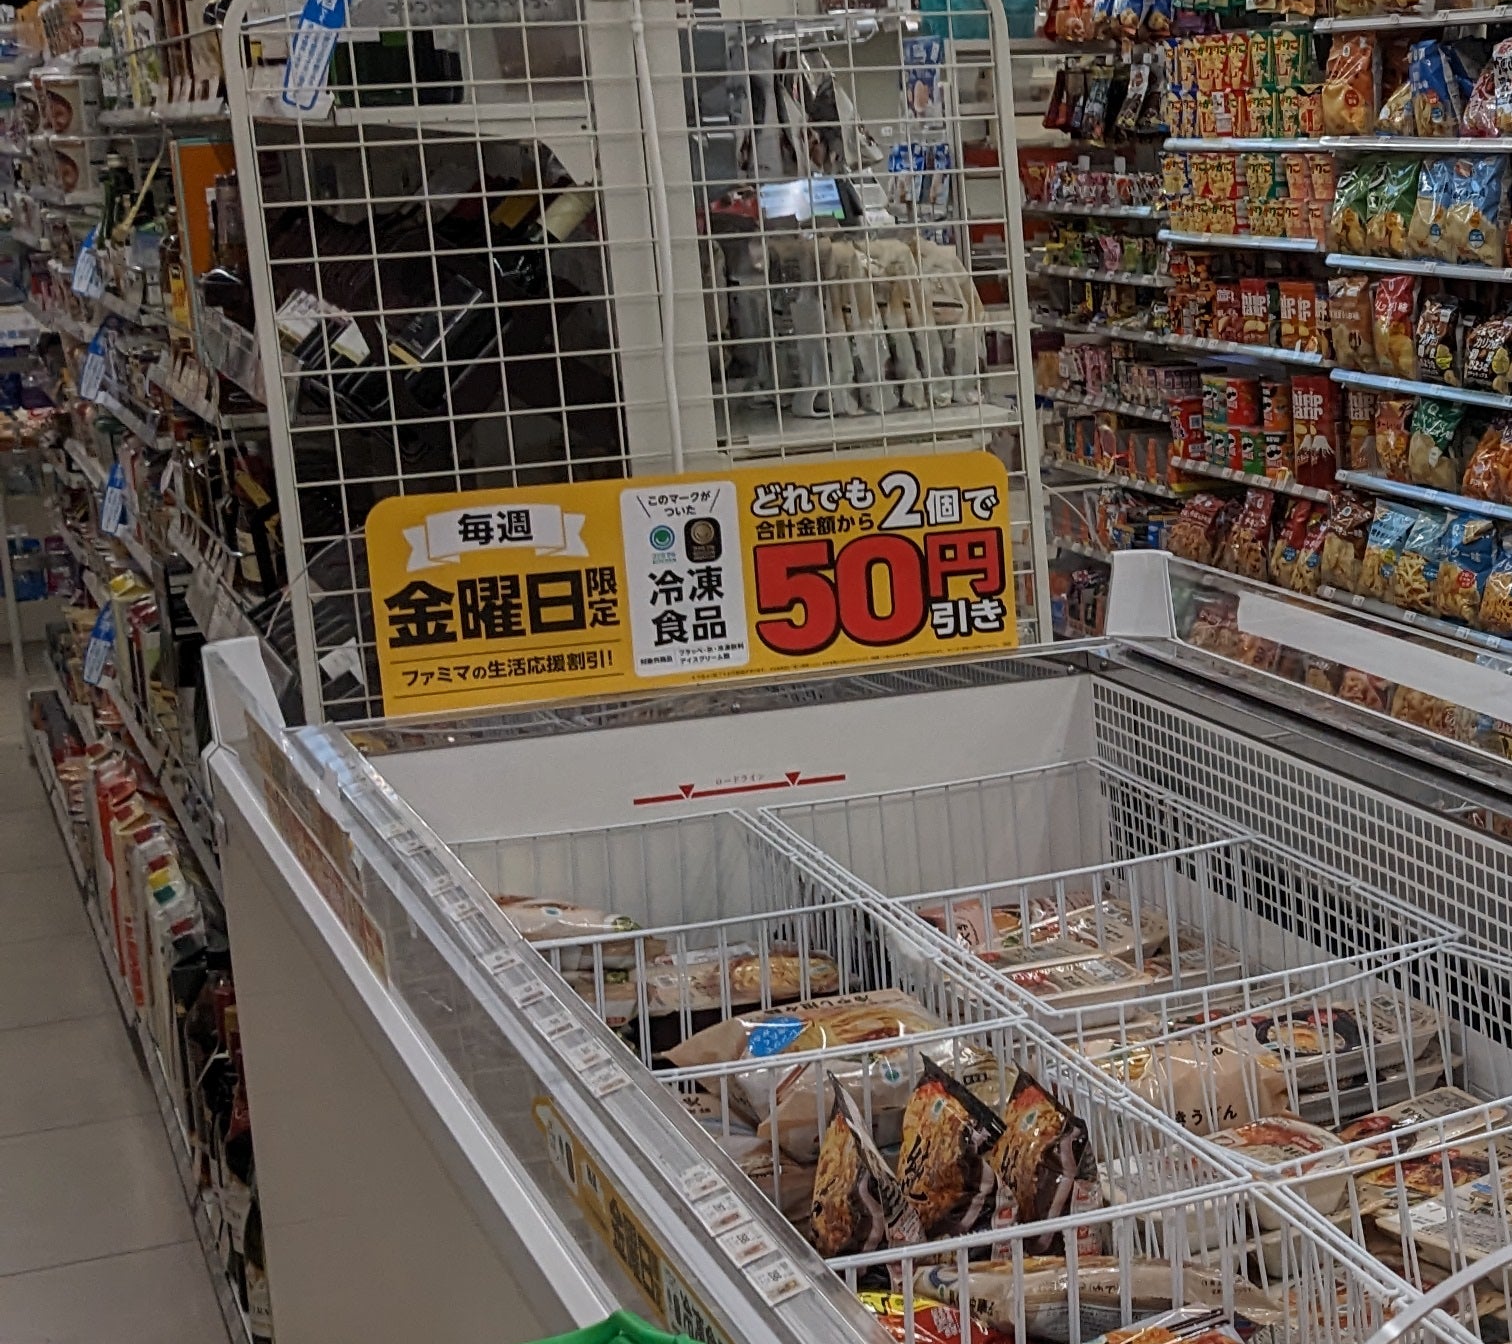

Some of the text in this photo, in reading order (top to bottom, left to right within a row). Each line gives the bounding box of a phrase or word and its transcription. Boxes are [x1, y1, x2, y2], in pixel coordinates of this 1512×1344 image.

[647, 490, 711, 508] このマークが
[663, 504, 697, 518] ついた
[751, 470, 1001, 531] どれでも2個で
[457, 509, 534, 546] 毎週
[754, 513, 875, 540] 合計金額から
[585, 565, 621, 629] 限定
[648, 565, 725, 606] 冷凍
[754, 526, 1005, 657] 50円
[383, 569, 587, 649] 金曜日
[652, 605, 728, 647] 食品
[715, 773, 764, 785] ロードライン
